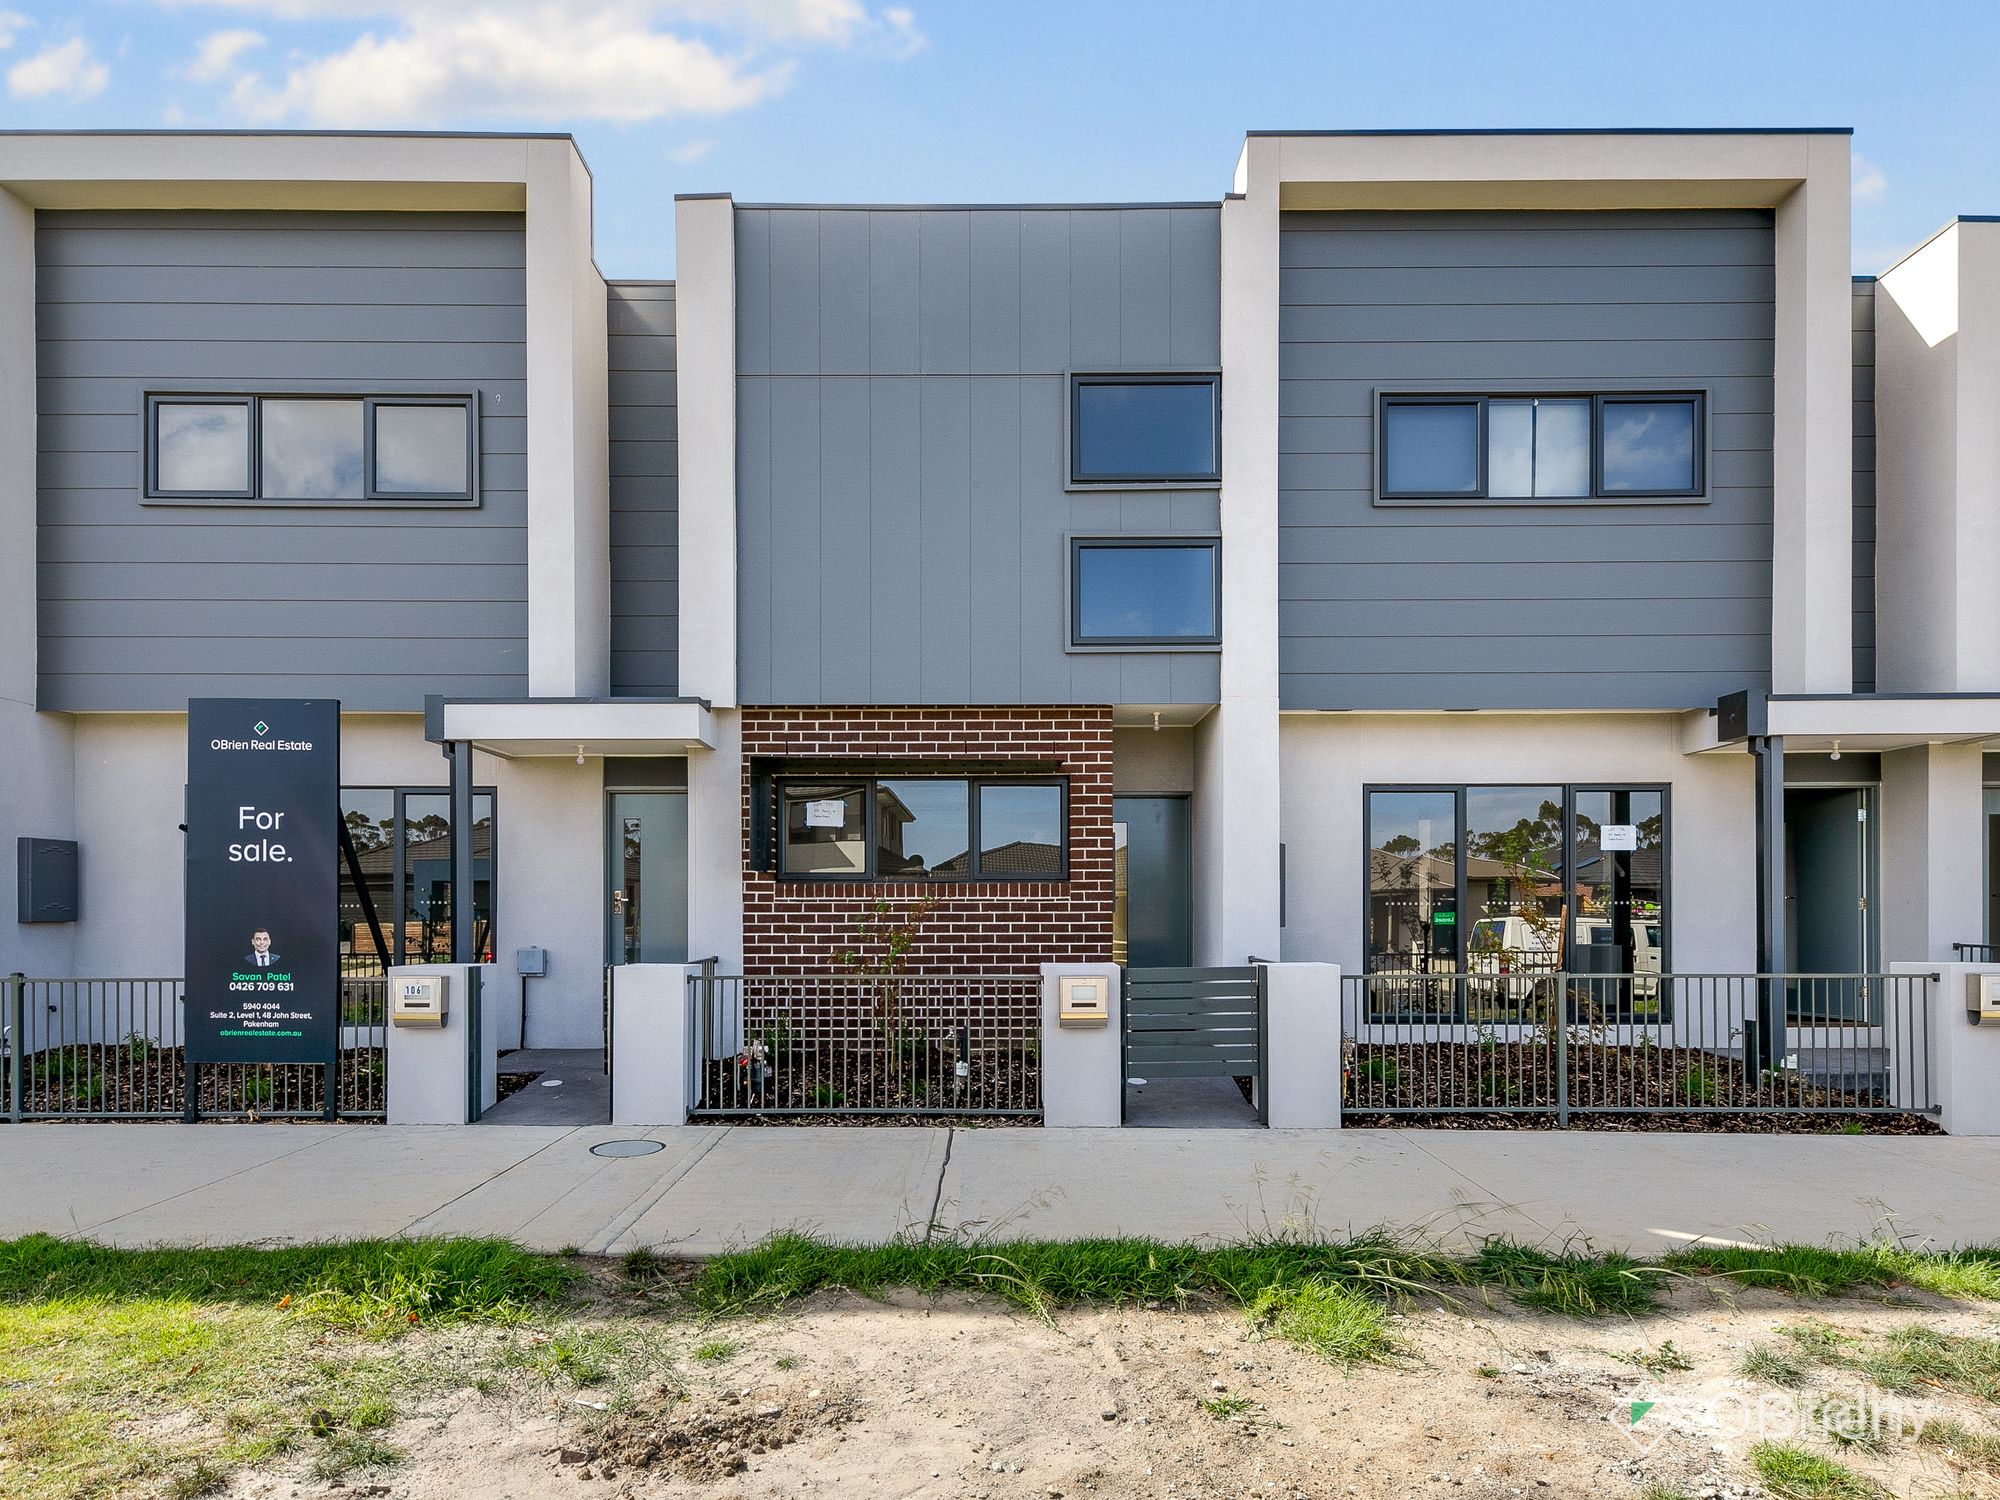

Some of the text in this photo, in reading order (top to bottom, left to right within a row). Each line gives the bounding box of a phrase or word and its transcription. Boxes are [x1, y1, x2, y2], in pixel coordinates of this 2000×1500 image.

[211, 740, 312, 750] OBrien Real Estate
[239, 806, 284, 830] For
[229, 839, 293, 862] sale.
[232, 972, 291, 981] Savan Patel
[229, 983, 294, 991] 0426 709 631
[406, 986, 421, 995] 106
[229, 1012, 235, 1020] 2,
[291, 1012, 312, 1020] Street,
